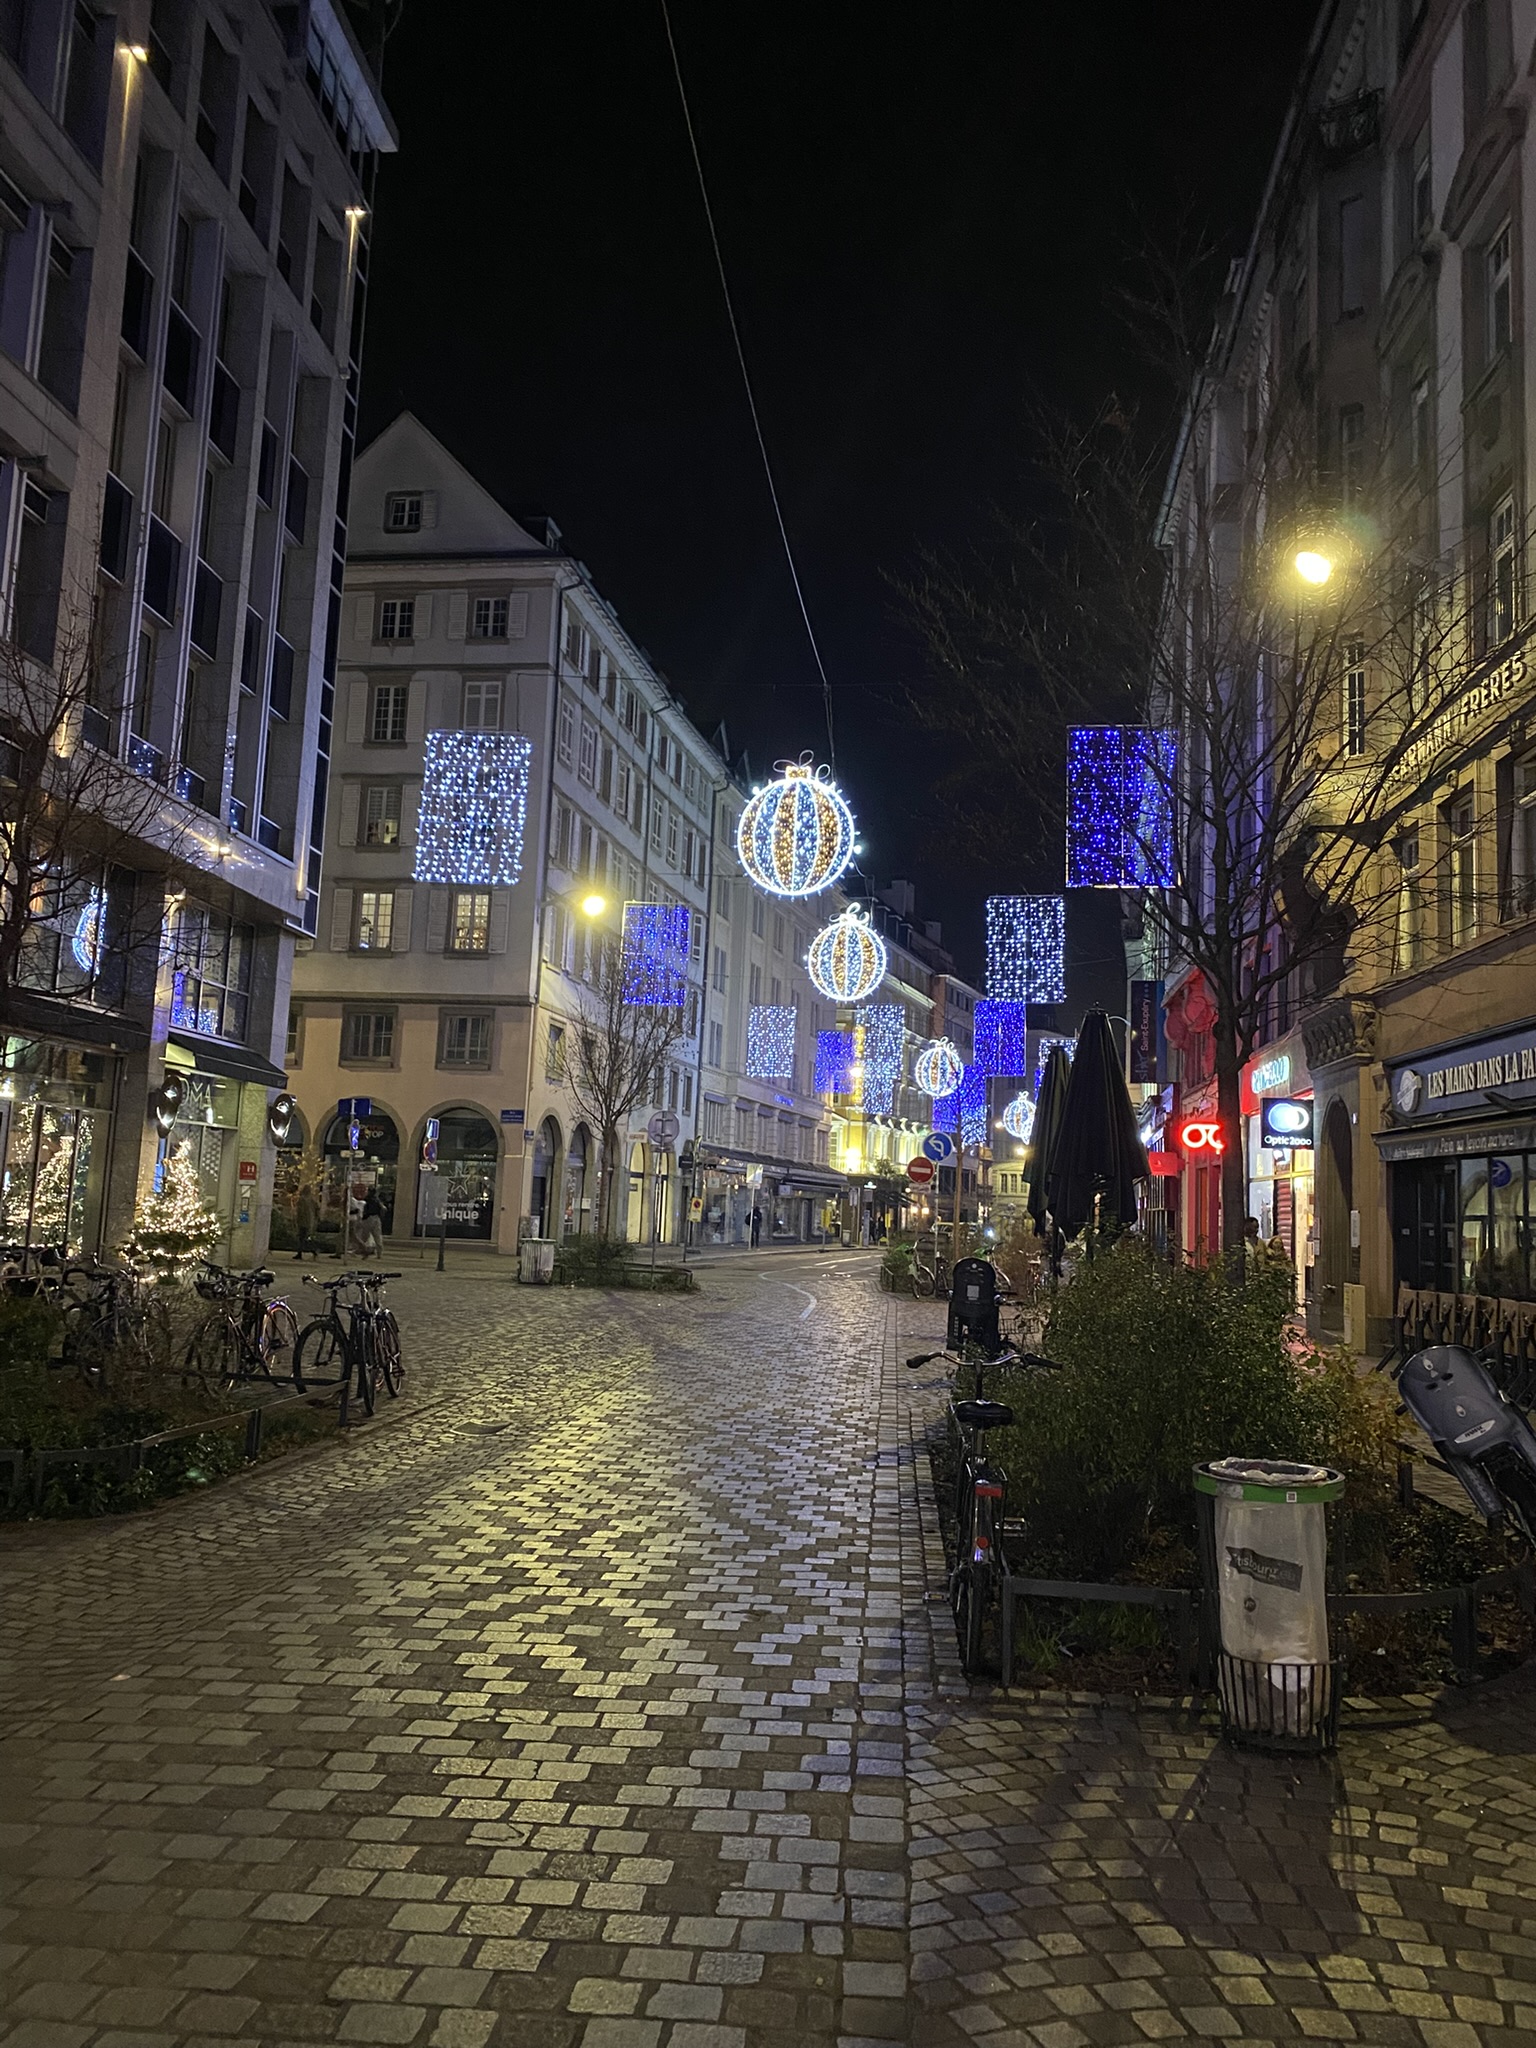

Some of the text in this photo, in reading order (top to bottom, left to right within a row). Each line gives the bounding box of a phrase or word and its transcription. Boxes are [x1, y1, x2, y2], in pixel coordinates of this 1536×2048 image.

[1427, 1070, 1445, 1099] LES
[1445, 1062, 1475, 1095] MAINS
[1476, 1055, 1503, 1089] DANS
[1504, 1052, 1520, 1083] LA
[1264, 1135, 1289, 1147] Optic
[434, 1207, 479, 1221] Unique
